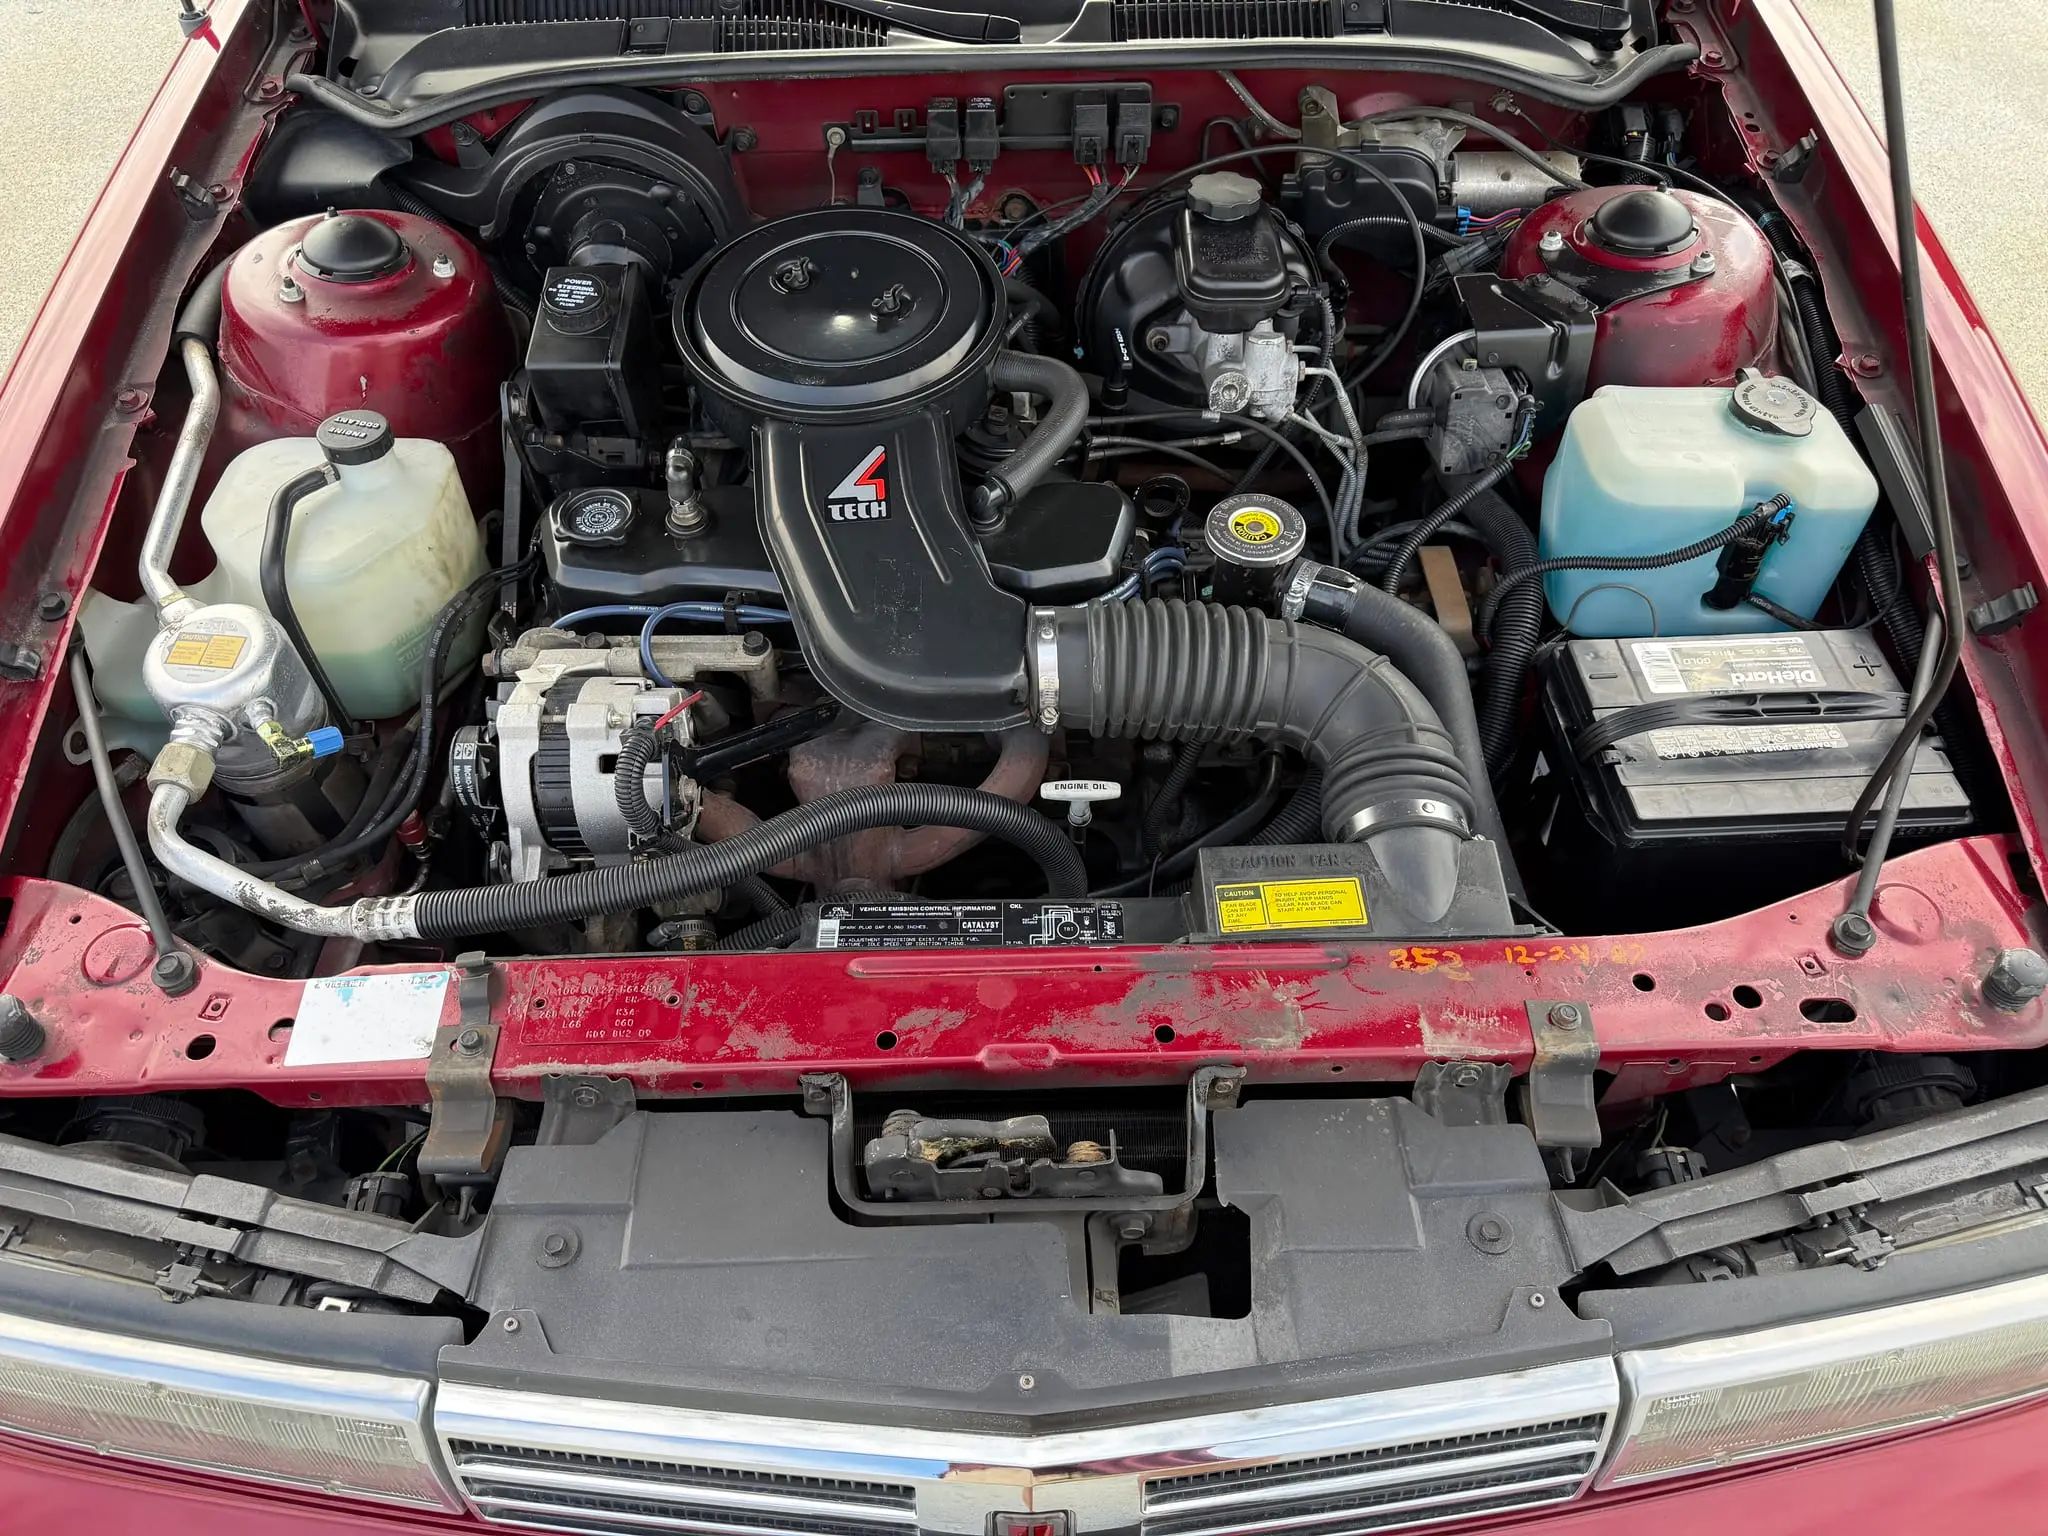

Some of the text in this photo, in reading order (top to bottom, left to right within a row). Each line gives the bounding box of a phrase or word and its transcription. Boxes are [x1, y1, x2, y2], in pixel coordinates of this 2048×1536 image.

[557, 284, 595, 292] STEERING
[564, 278, 593, 286] POWER
[334, 416, 381, 429] COOLANT
[328, 426, 368, 439] ENGINE
[827, 501, 887, 520] TECH
[1235, 524, 1268, 541] CAUTION
[1682, 657, 1711, 666] GOLD
[1731, 668, 1816, 686] DieHard
[1229, 852, 1341, 869] CAUTION FAN
[1223, 889, 1255, 897] CAUTION
[962, 920, 1000, 929] CATALYST
